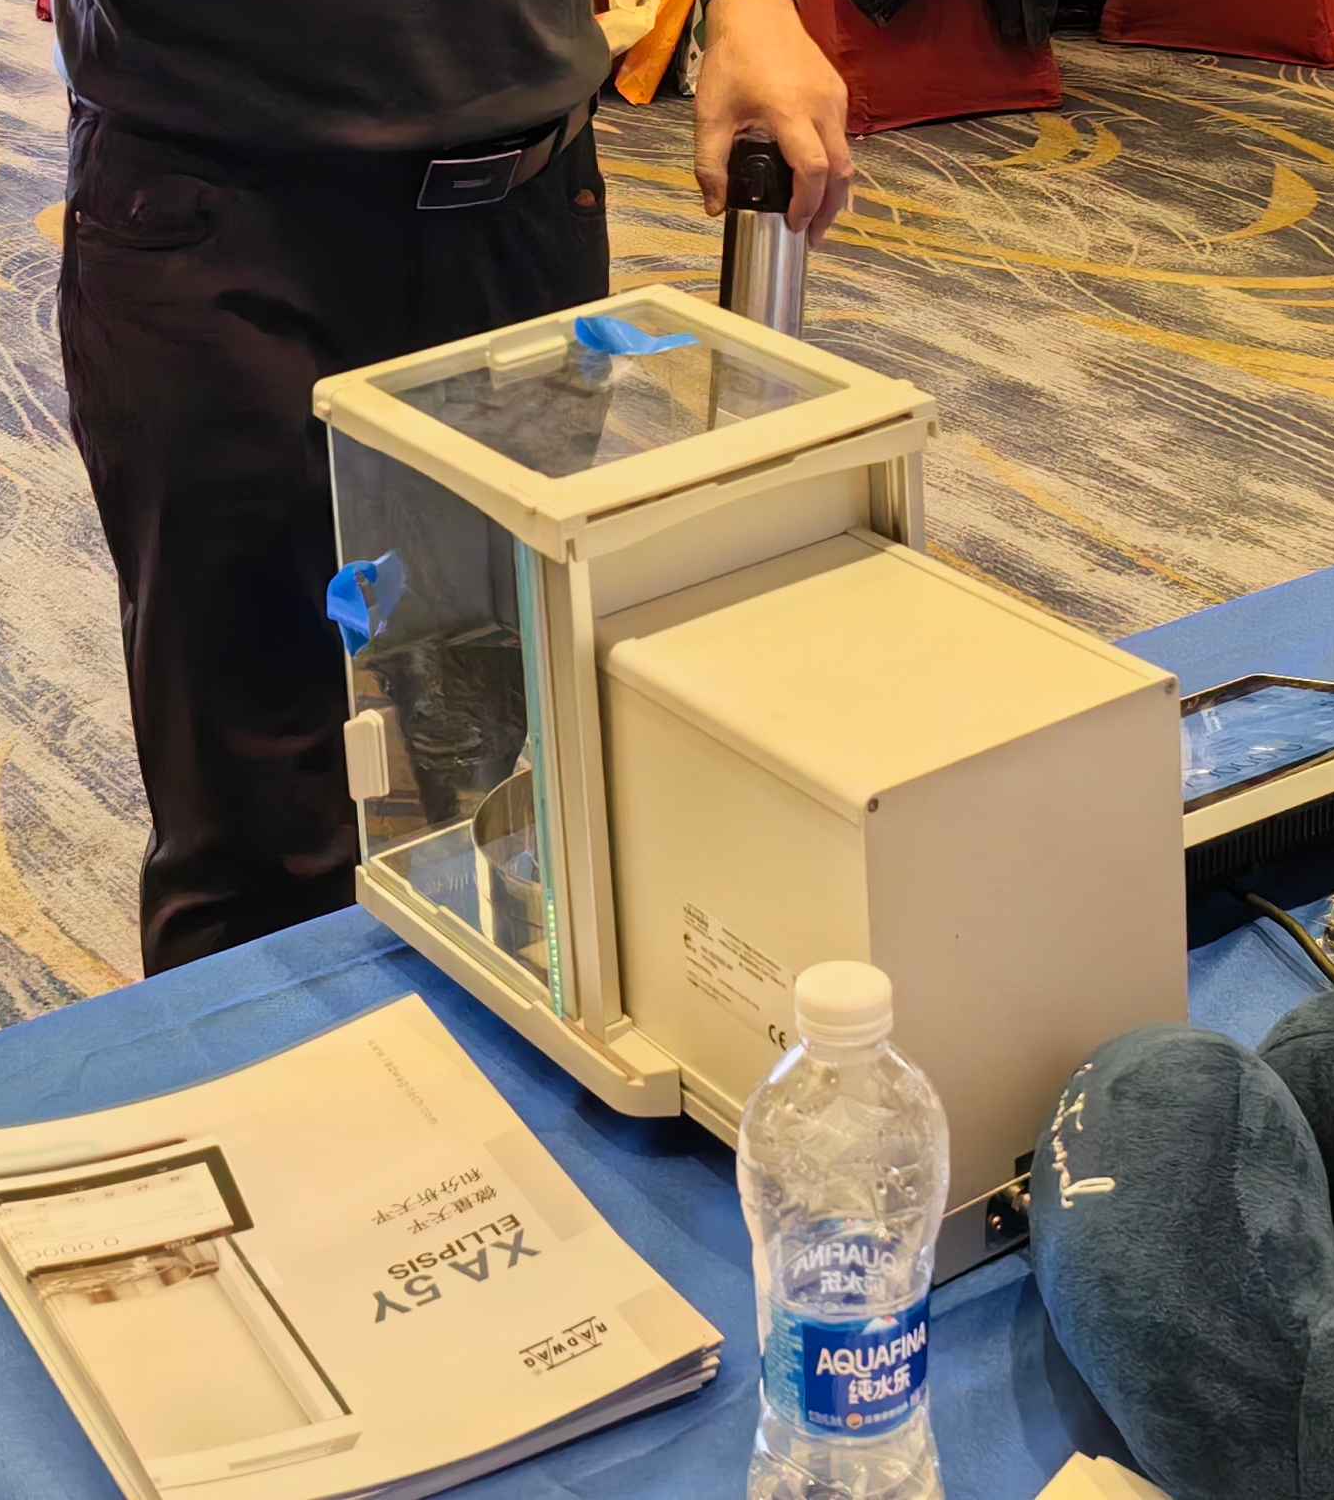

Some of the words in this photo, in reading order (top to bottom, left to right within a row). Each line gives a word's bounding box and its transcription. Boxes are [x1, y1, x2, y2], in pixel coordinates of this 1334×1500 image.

[371, 1167, 485, 1225] 和分析天平
[406, 1184, 498, 1235] 微量天平
[387, 1213, 522, 1280] ELLIPSIS
[447, 1227, 542, 1283] XA
[372, 1273, 443, 1324] 5Y
[521, 1318, 608, 1370] RADWAG
[814, 1320, 927, 1378] AQUAFINA
[848, 1362, 911, 1405] 纯水乐
